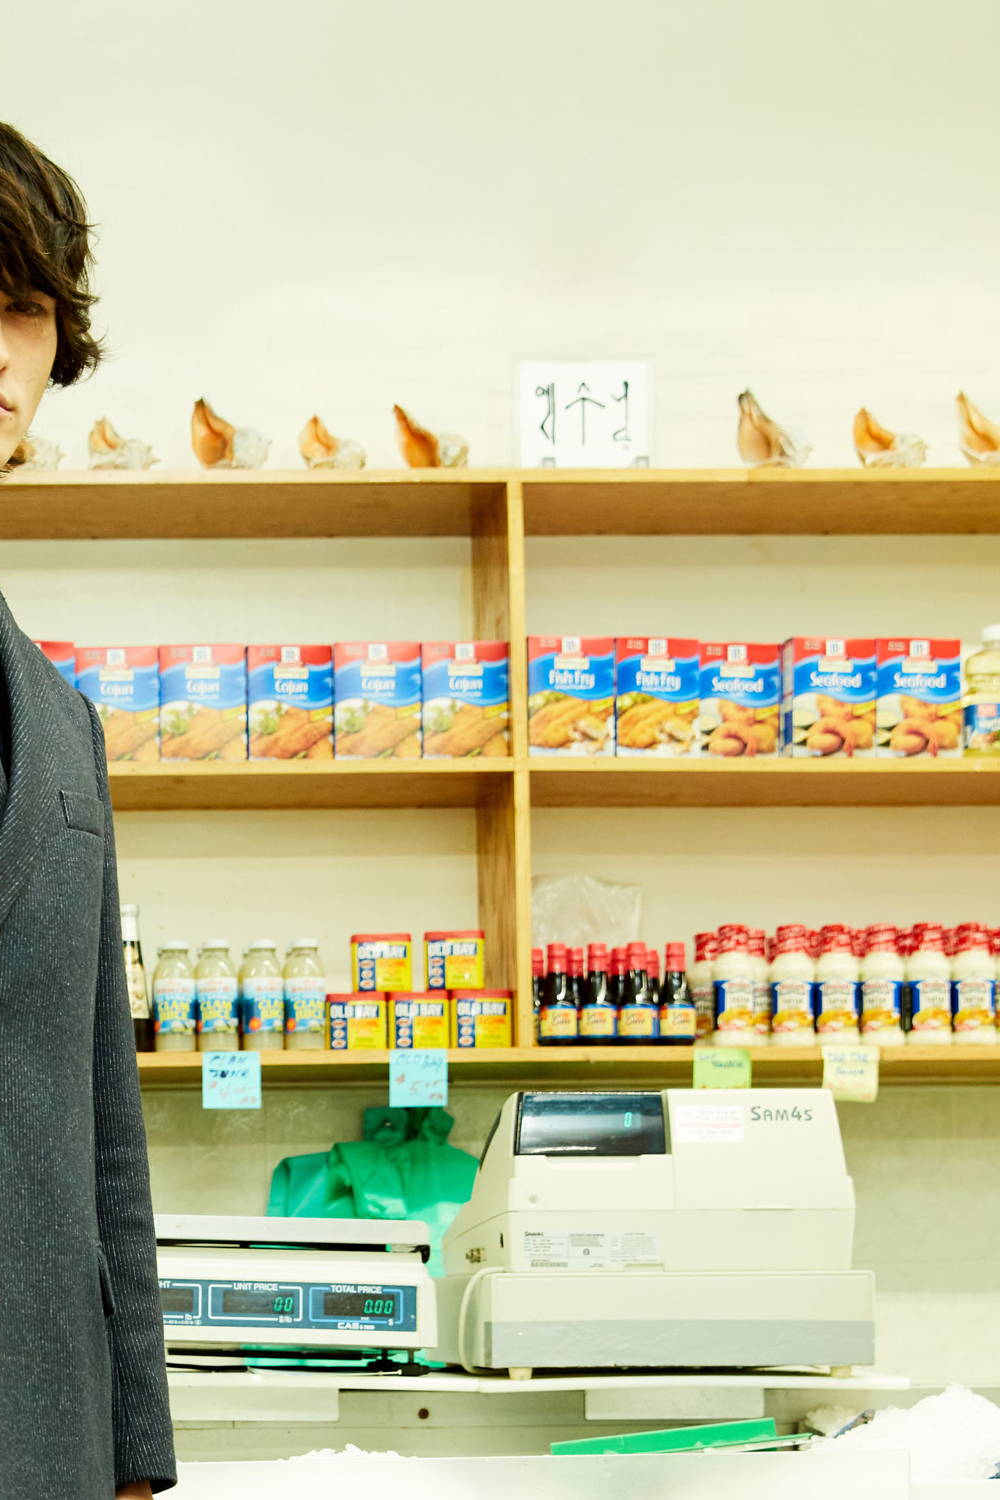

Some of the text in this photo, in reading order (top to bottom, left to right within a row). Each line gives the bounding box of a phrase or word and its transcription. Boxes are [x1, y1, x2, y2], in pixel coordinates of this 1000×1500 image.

[274, 677, 309, 695] Cajun
[711, 676, 764, 693] Seafood
[809, 671, 862, 689] Seafood
[893, 672, 946, 690] Seafood
[452, 942, 478, 957] BAY
[330, 1003, 355, 1018] OLD
[395, 1001, 444, 1017] OLD BAY
[457, 1001, 507, 1017] OLD BAY
[233, 1282, 278, 1292] UNIT PRICE
[330, 1284, 383, 1295] TOTAL PRICE
